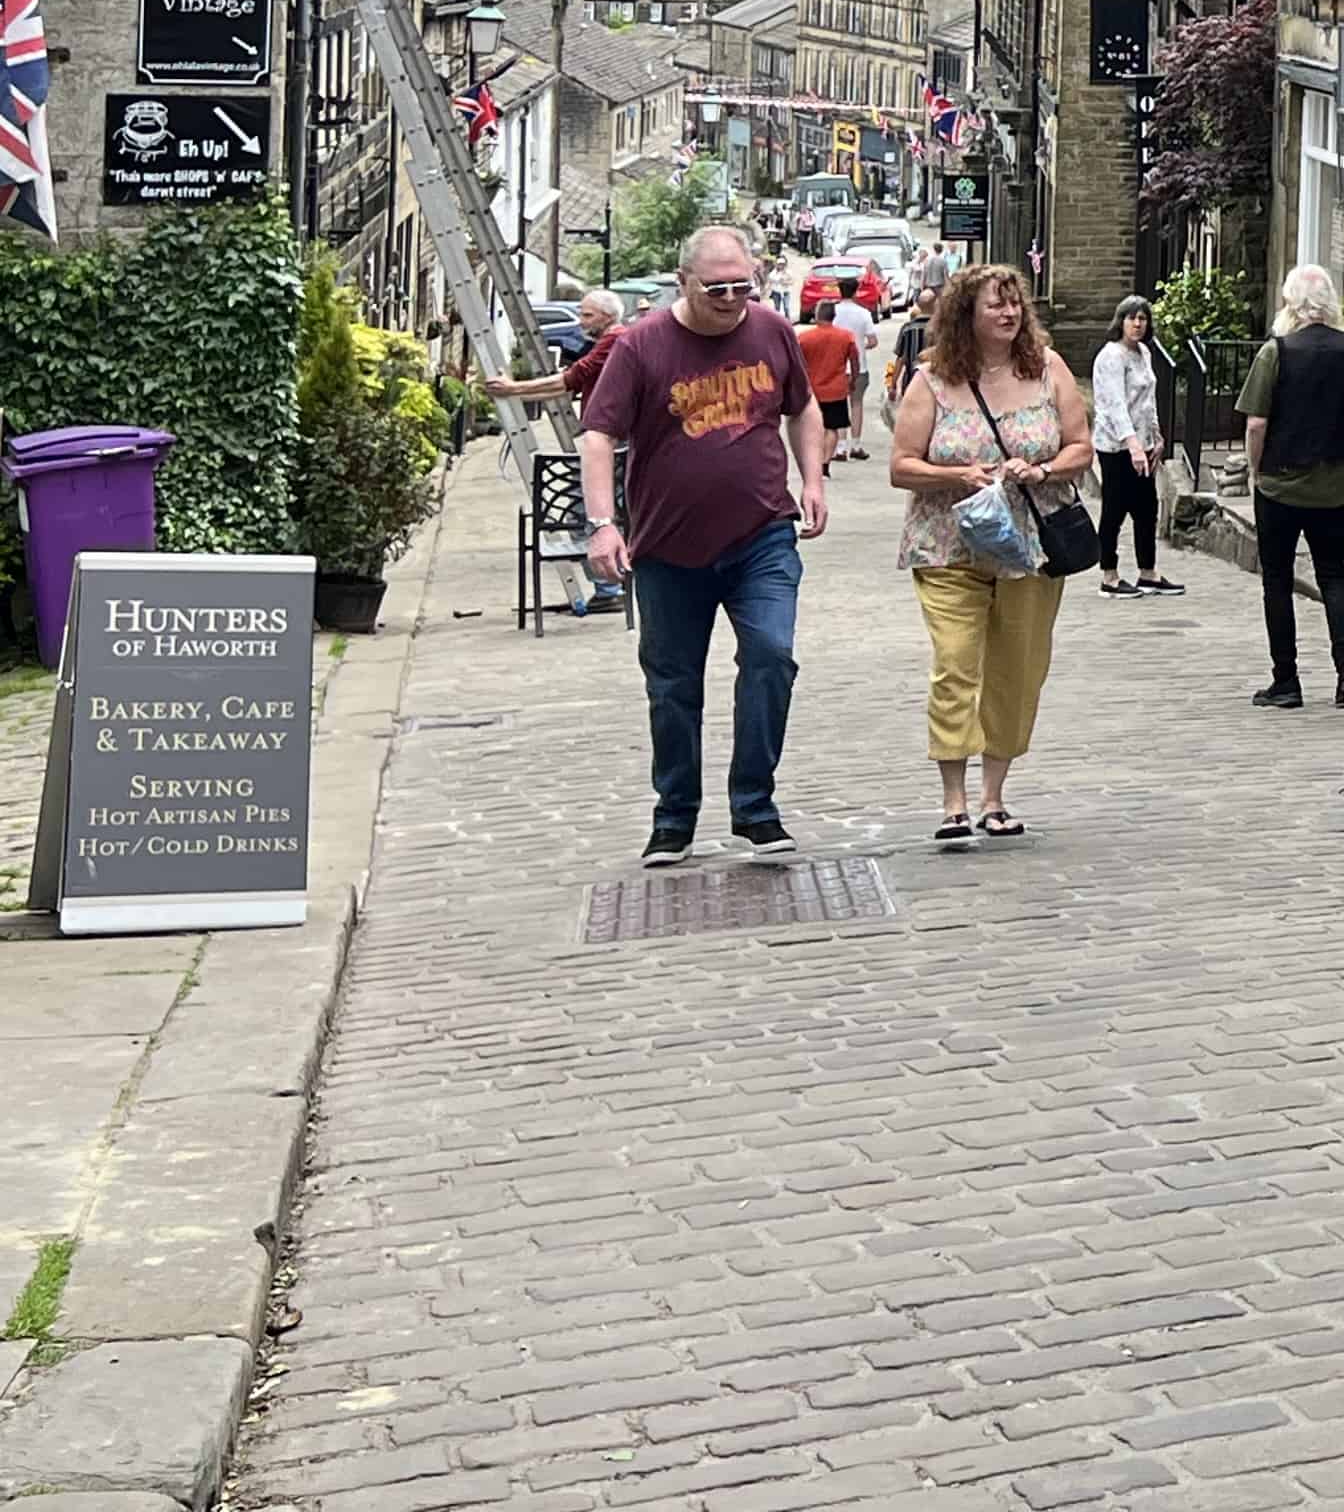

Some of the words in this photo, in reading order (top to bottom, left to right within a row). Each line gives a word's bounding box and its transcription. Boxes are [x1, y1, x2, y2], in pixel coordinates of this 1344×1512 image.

[179, 140, 198, 158] Eh
[202, 140, 229, 161] Up!
[104, 599, 288, 633] HUNTERS
[112, 639, 146, 657] OF
[153, 635, 277, 657] HAWORTH
[89, 696, 211, 722] BAKERY,
[221, 695, 295, 720] CAFE
[96, 727, 119, 752] &
[128, 727, 287, 751] TAKEAWAY
[129, 775, 255, 799] SERVING
[88, 807, 140, 826] HOT
[144, 806, 237, 825] ARTISAN
[244, 804, 291, 823] PIES
[78, 836, 210, 857] HOT/COLD
[215, 835, 299, 854] DRINKS
